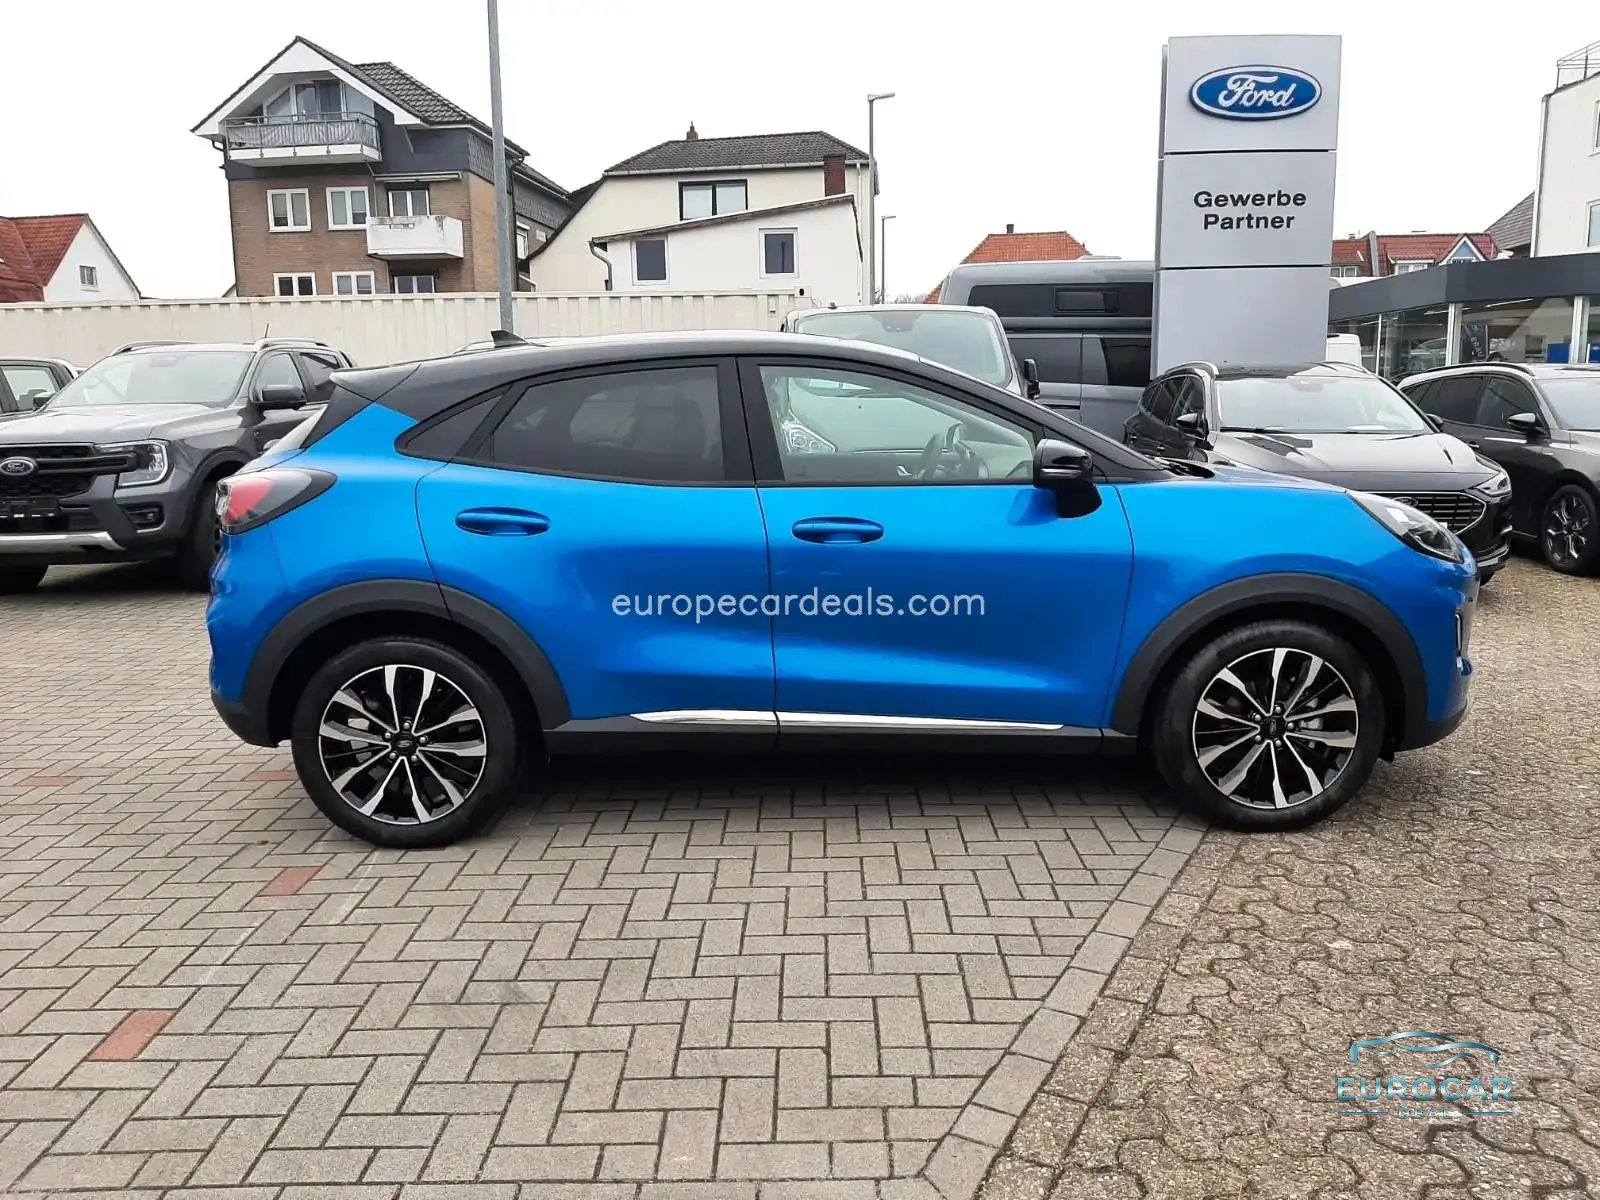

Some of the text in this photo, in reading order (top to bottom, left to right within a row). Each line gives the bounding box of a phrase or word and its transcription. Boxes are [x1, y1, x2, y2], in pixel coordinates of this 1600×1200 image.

[1218, 73, 1296, 107] Ford
[1193, 190, 1306, 208] Gewerbe
[1203, 213, 1295, 230] Partner
